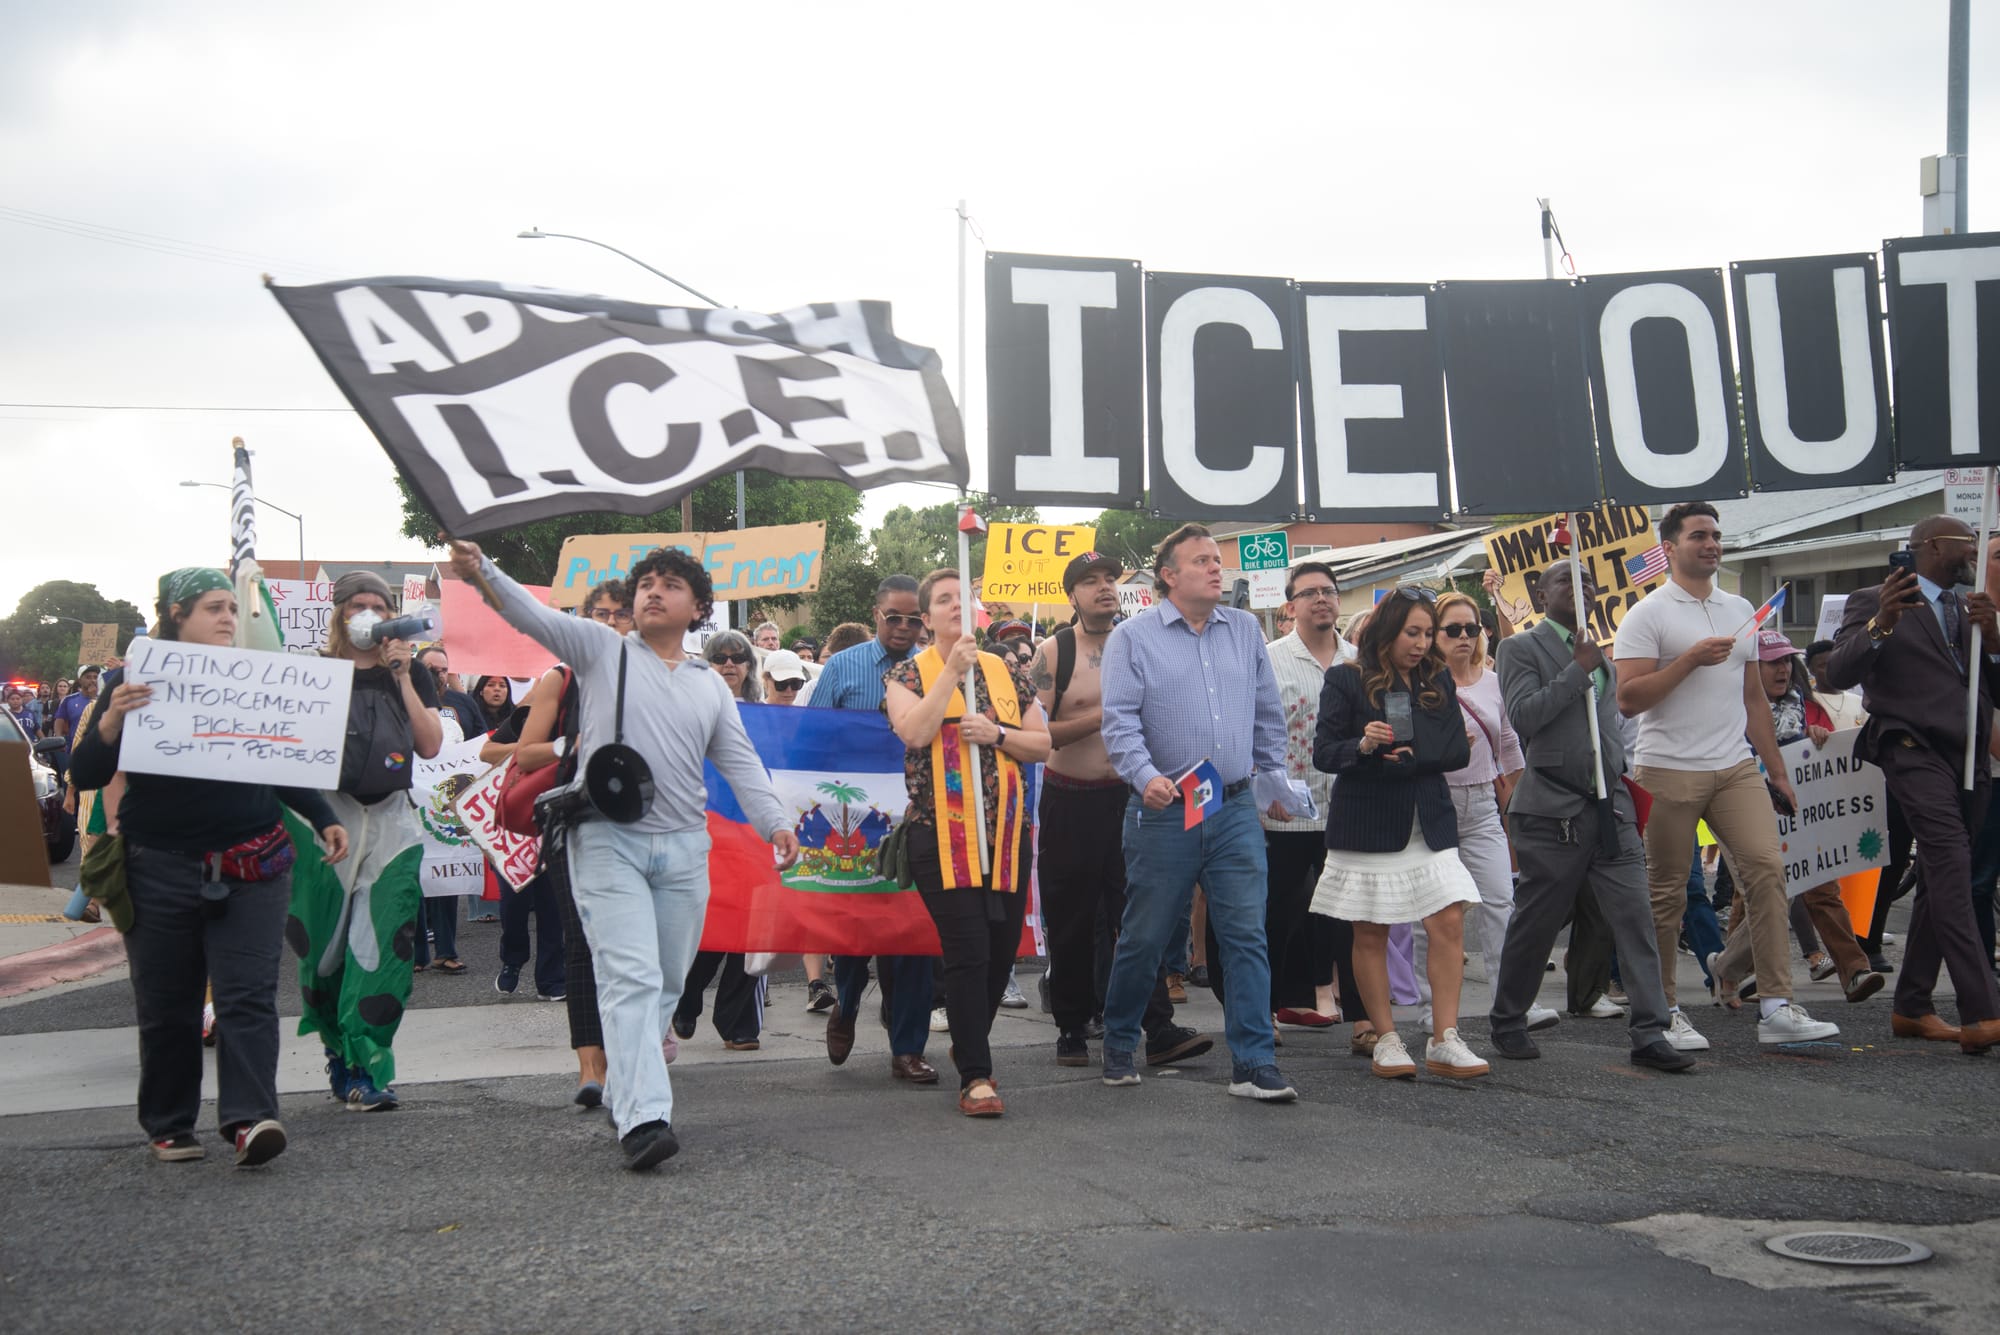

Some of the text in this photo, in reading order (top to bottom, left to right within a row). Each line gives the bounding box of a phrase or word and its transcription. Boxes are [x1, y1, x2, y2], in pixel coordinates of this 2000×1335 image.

[1010, 246, 2000, 511] ICE OUT
[1956, 492, 1984, 500] MONDA
[1004, 528, 1076, 557] ICE
[1002, 558, 1050, 576] OUT
[1244, 558, 1286, 570] BIKE ROUTE
[988, 581, 1065, 596] CITY HEIGH
[279, 607, 333, 629] HISTO
[139, 647, 332, 691] LATINO LAW
[138, 714, 297, 739] IS PICK-ME
[242, 739, 337, 765] PENDEJOS
[1795, 756, 1863, 785] DEMAND
[1778, 795, 1874, 836] UE PROCESS
[1785, 845, 1849, 883] FOR ALL!
